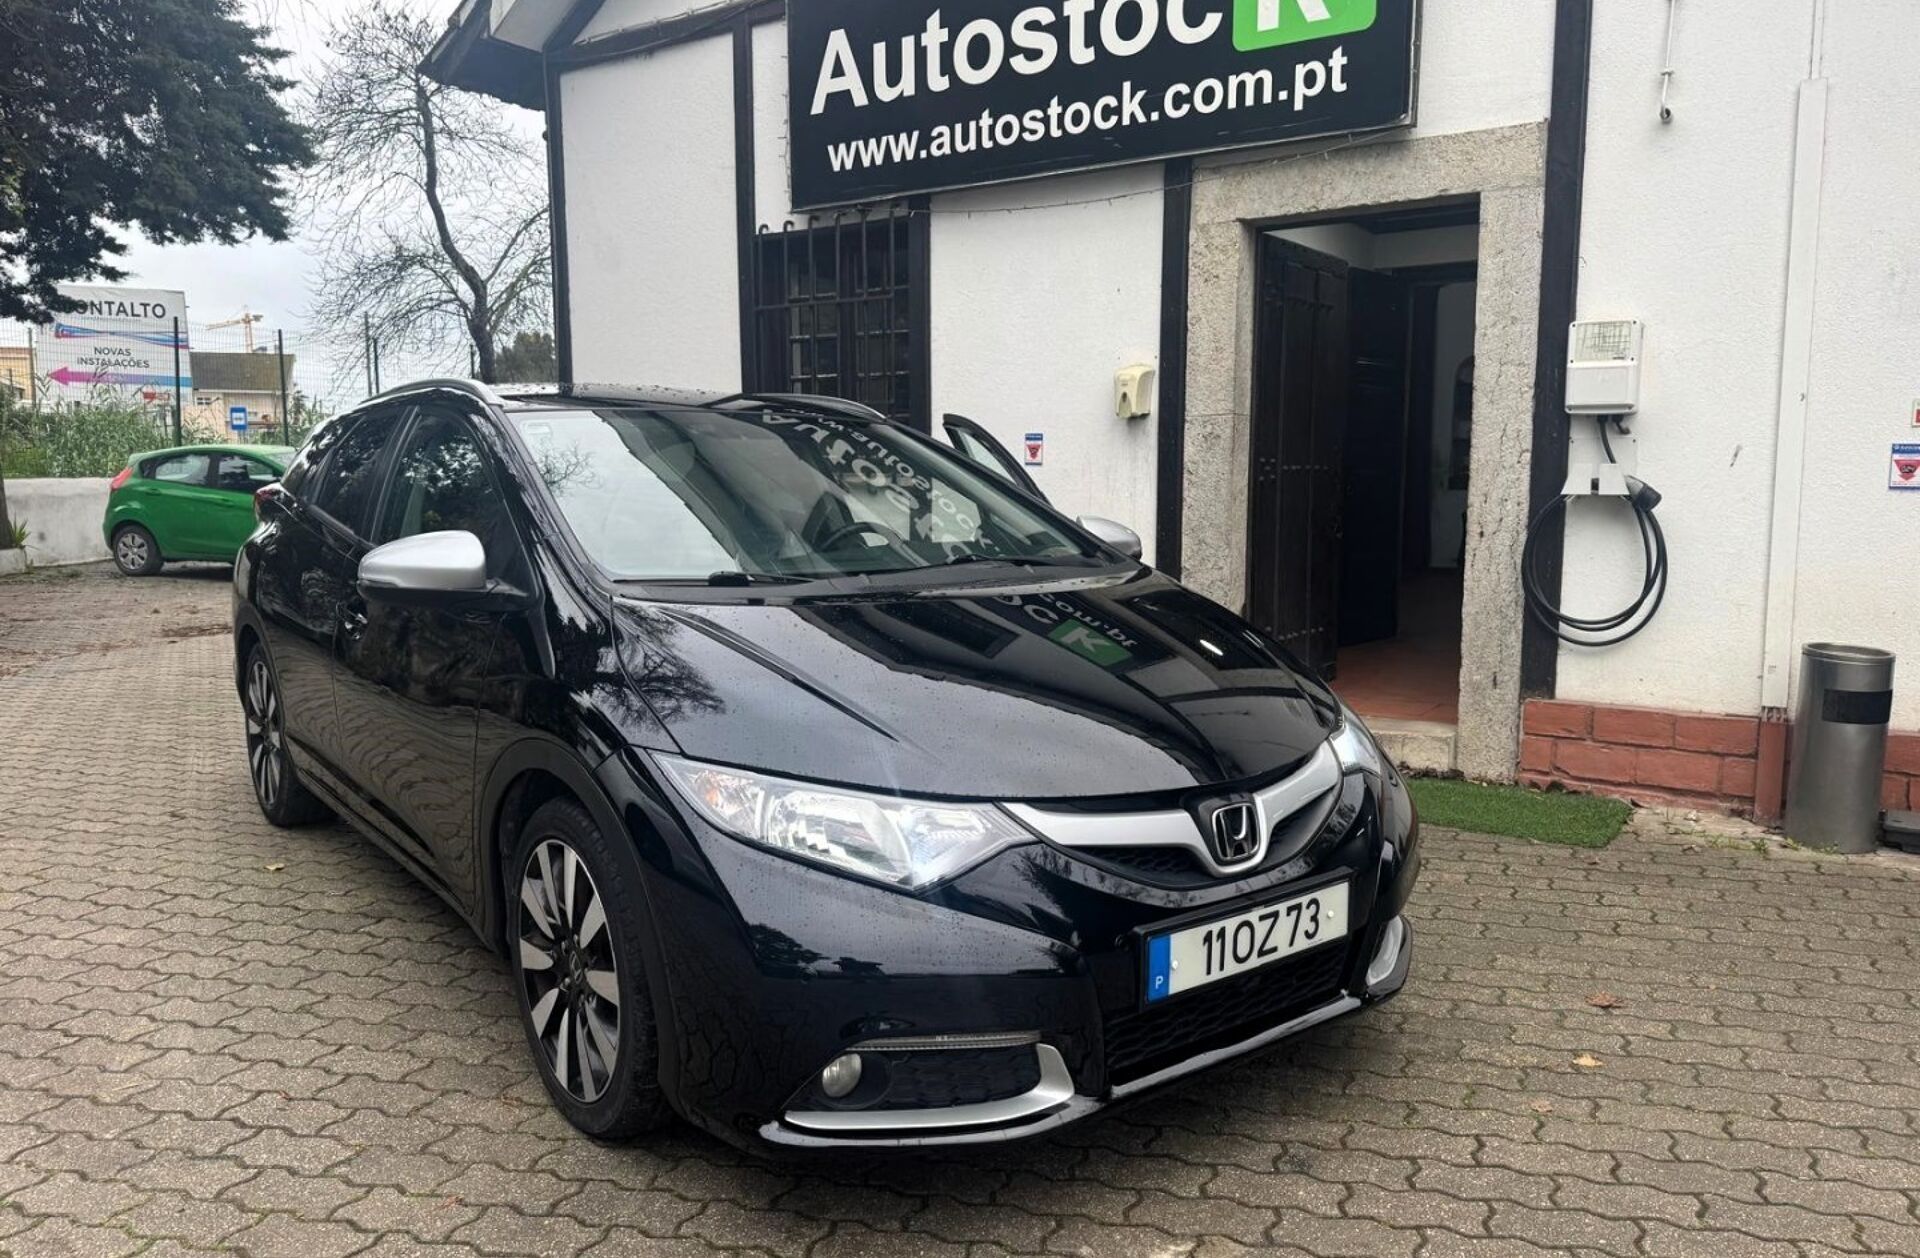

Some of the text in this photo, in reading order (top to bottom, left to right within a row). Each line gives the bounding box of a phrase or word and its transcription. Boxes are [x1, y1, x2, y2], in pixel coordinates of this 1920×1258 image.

[826, 46, 1348, 172] www.autostock.com.pt
[74, 300, 166, 318] ONTALTO
[94, 347, 131, 357] NOVAS
[77, 357, 150, 369] INSTALAÇÕES
[1155, 975, 1164, 989] P
